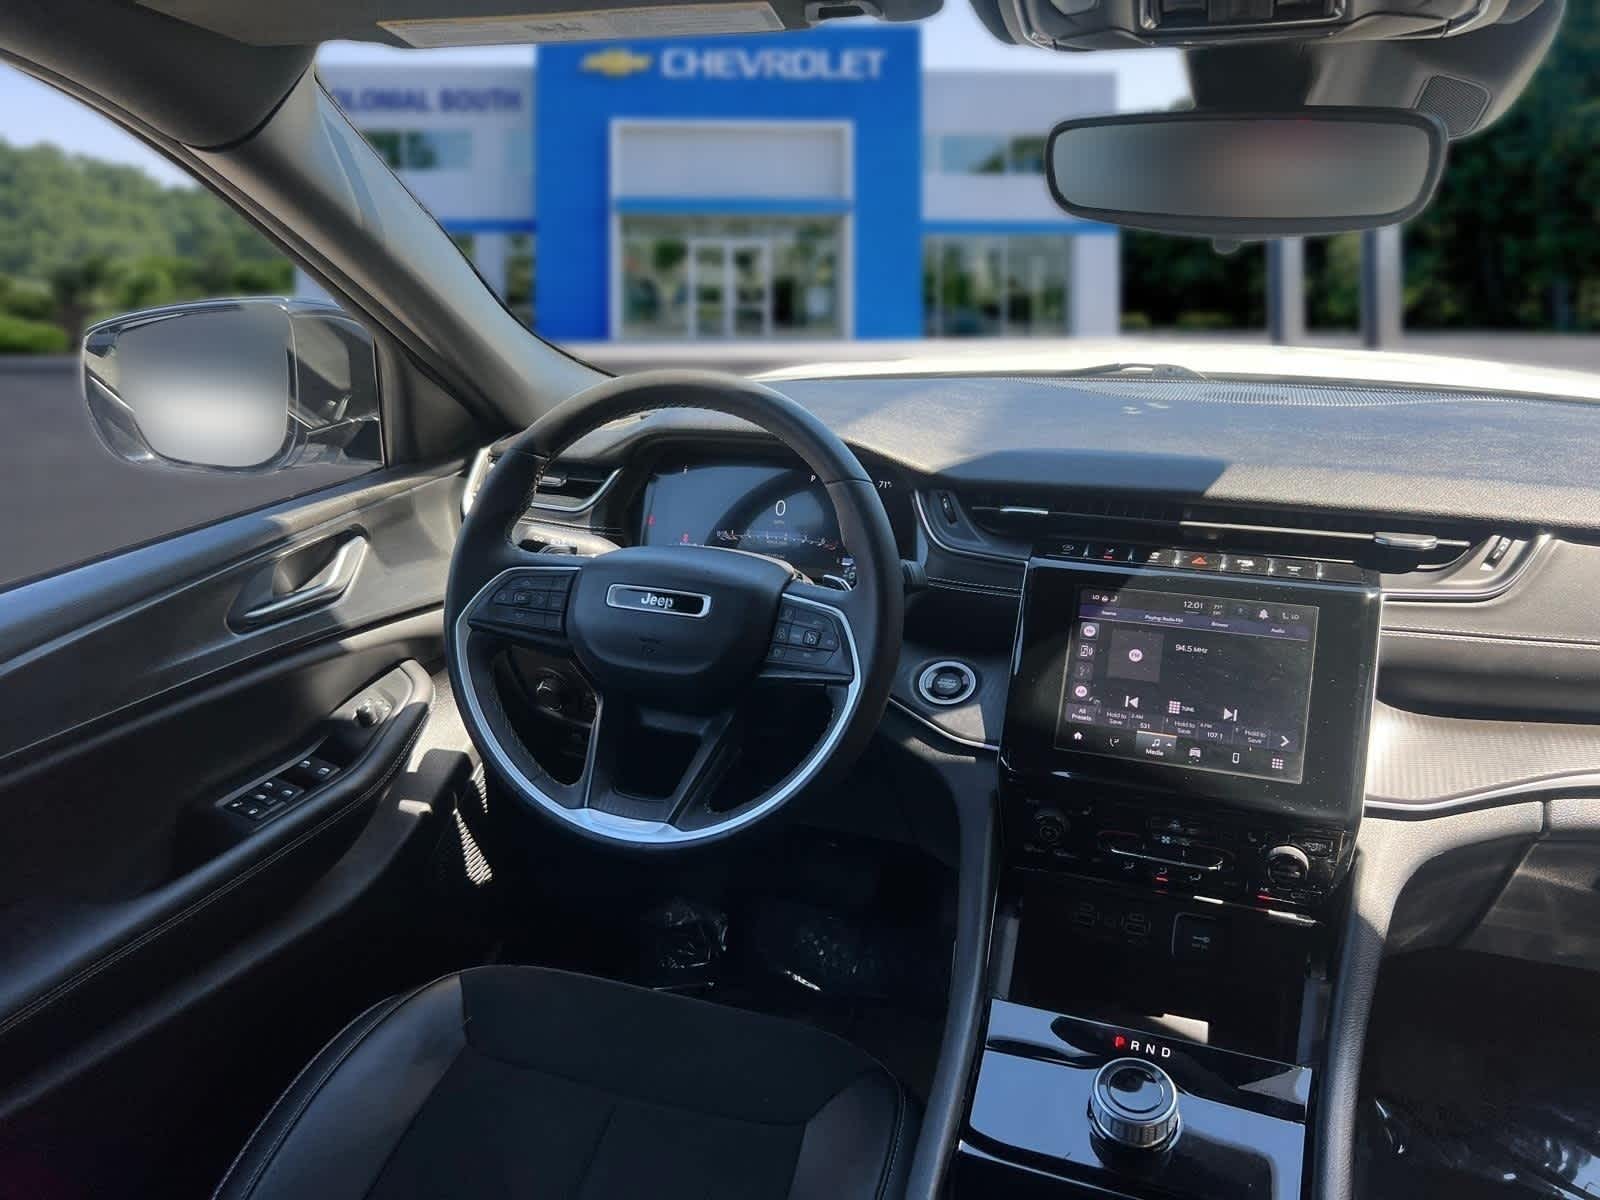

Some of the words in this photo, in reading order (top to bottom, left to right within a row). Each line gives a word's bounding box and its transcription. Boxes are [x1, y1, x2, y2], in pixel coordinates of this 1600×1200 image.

[661, 49, 886, 79] CHEVROLET
[331, 88, 430, 112] OLONIAL
[438, 88, 522, 112] SOUTH
[775, 500, 786, 516] 0
[641, 592, 673, 609] Jeep
[1175, 643, 1193, 653] 94.5
[1071, 713, 1092, 721] Presets
[1145, 748, 1164, 757] Media
[1130, 1040, 1140, 1051] R
[1145, 1043, 1156, 1055] N
[1161, 1047, 1171, 1058] D
